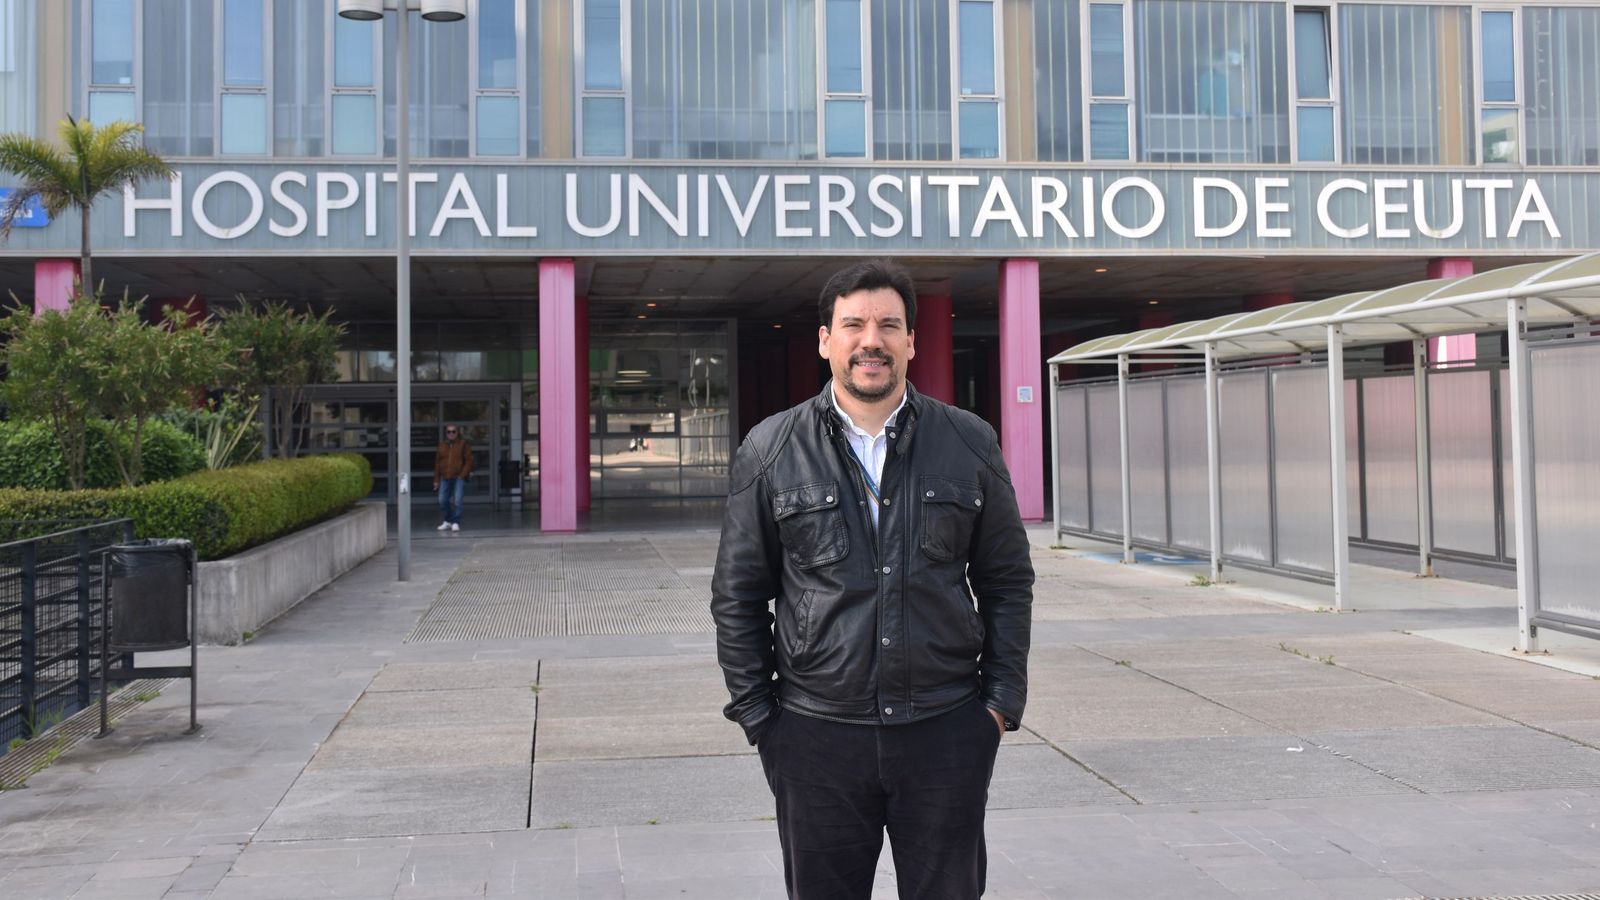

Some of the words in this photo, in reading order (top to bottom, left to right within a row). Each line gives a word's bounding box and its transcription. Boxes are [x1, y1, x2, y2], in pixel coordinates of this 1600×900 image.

[123, 170, 537, 239] HOSPITAL
[565, 172, 1165, 238] UNIVERSITARIO
[1193, 177, 1292, 238] DE
[1316, 178, 1562, 239] CEUTA
